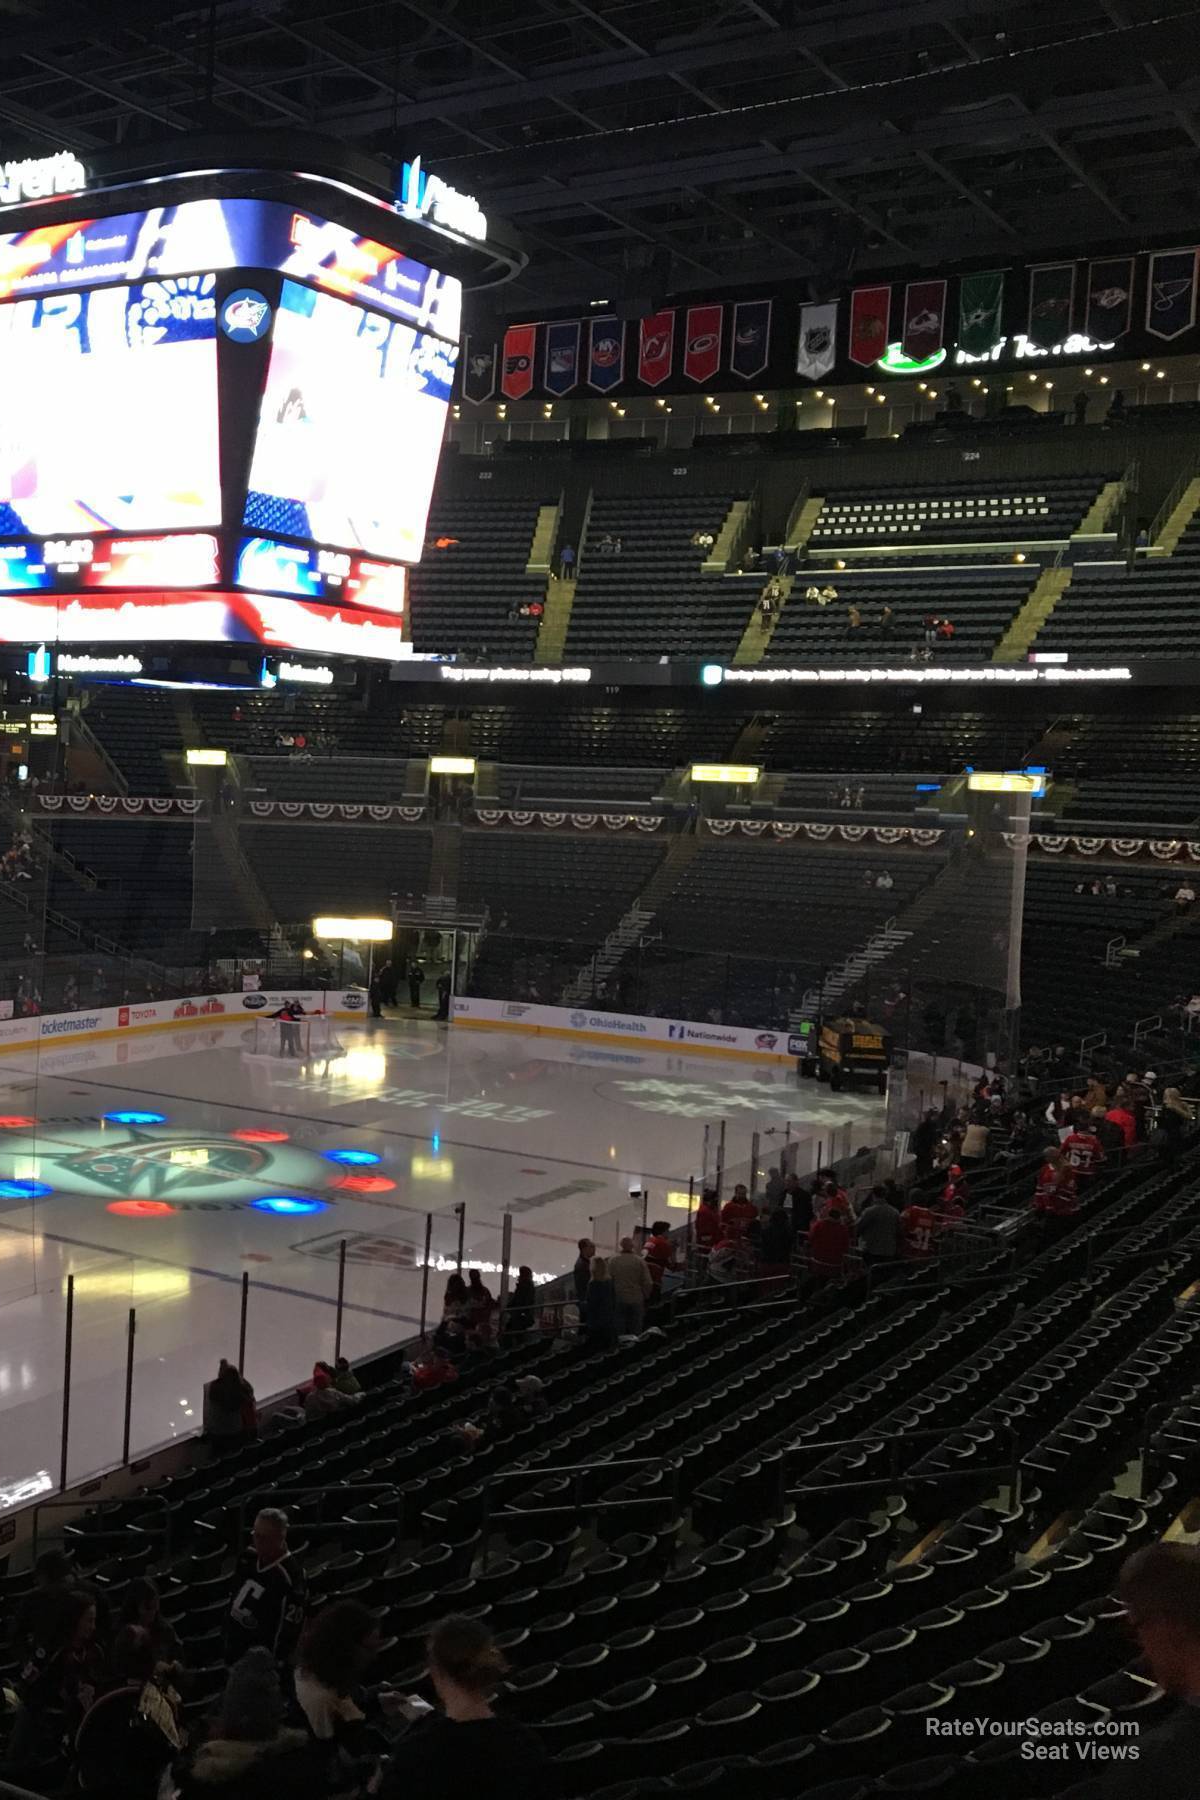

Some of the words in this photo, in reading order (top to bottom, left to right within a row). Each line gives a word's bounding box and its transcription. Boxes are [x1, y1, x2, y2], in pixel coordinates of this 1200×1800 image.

[57, 653, 143, 673] Nationwide
[441, 666, 463, 681] Tag
[463, 668, 490, 681] your
[530, 667, 561, 683] using
[131, 1009, 157, 1021] TOYOTA
[41, 1016, 100, 1035] ticketmaster
[589, 1017, 647, 1033] OhioHealth
[686, 1029, 737, 1043] Nationwide
[1069, 1150, 1093, 1167] 67
